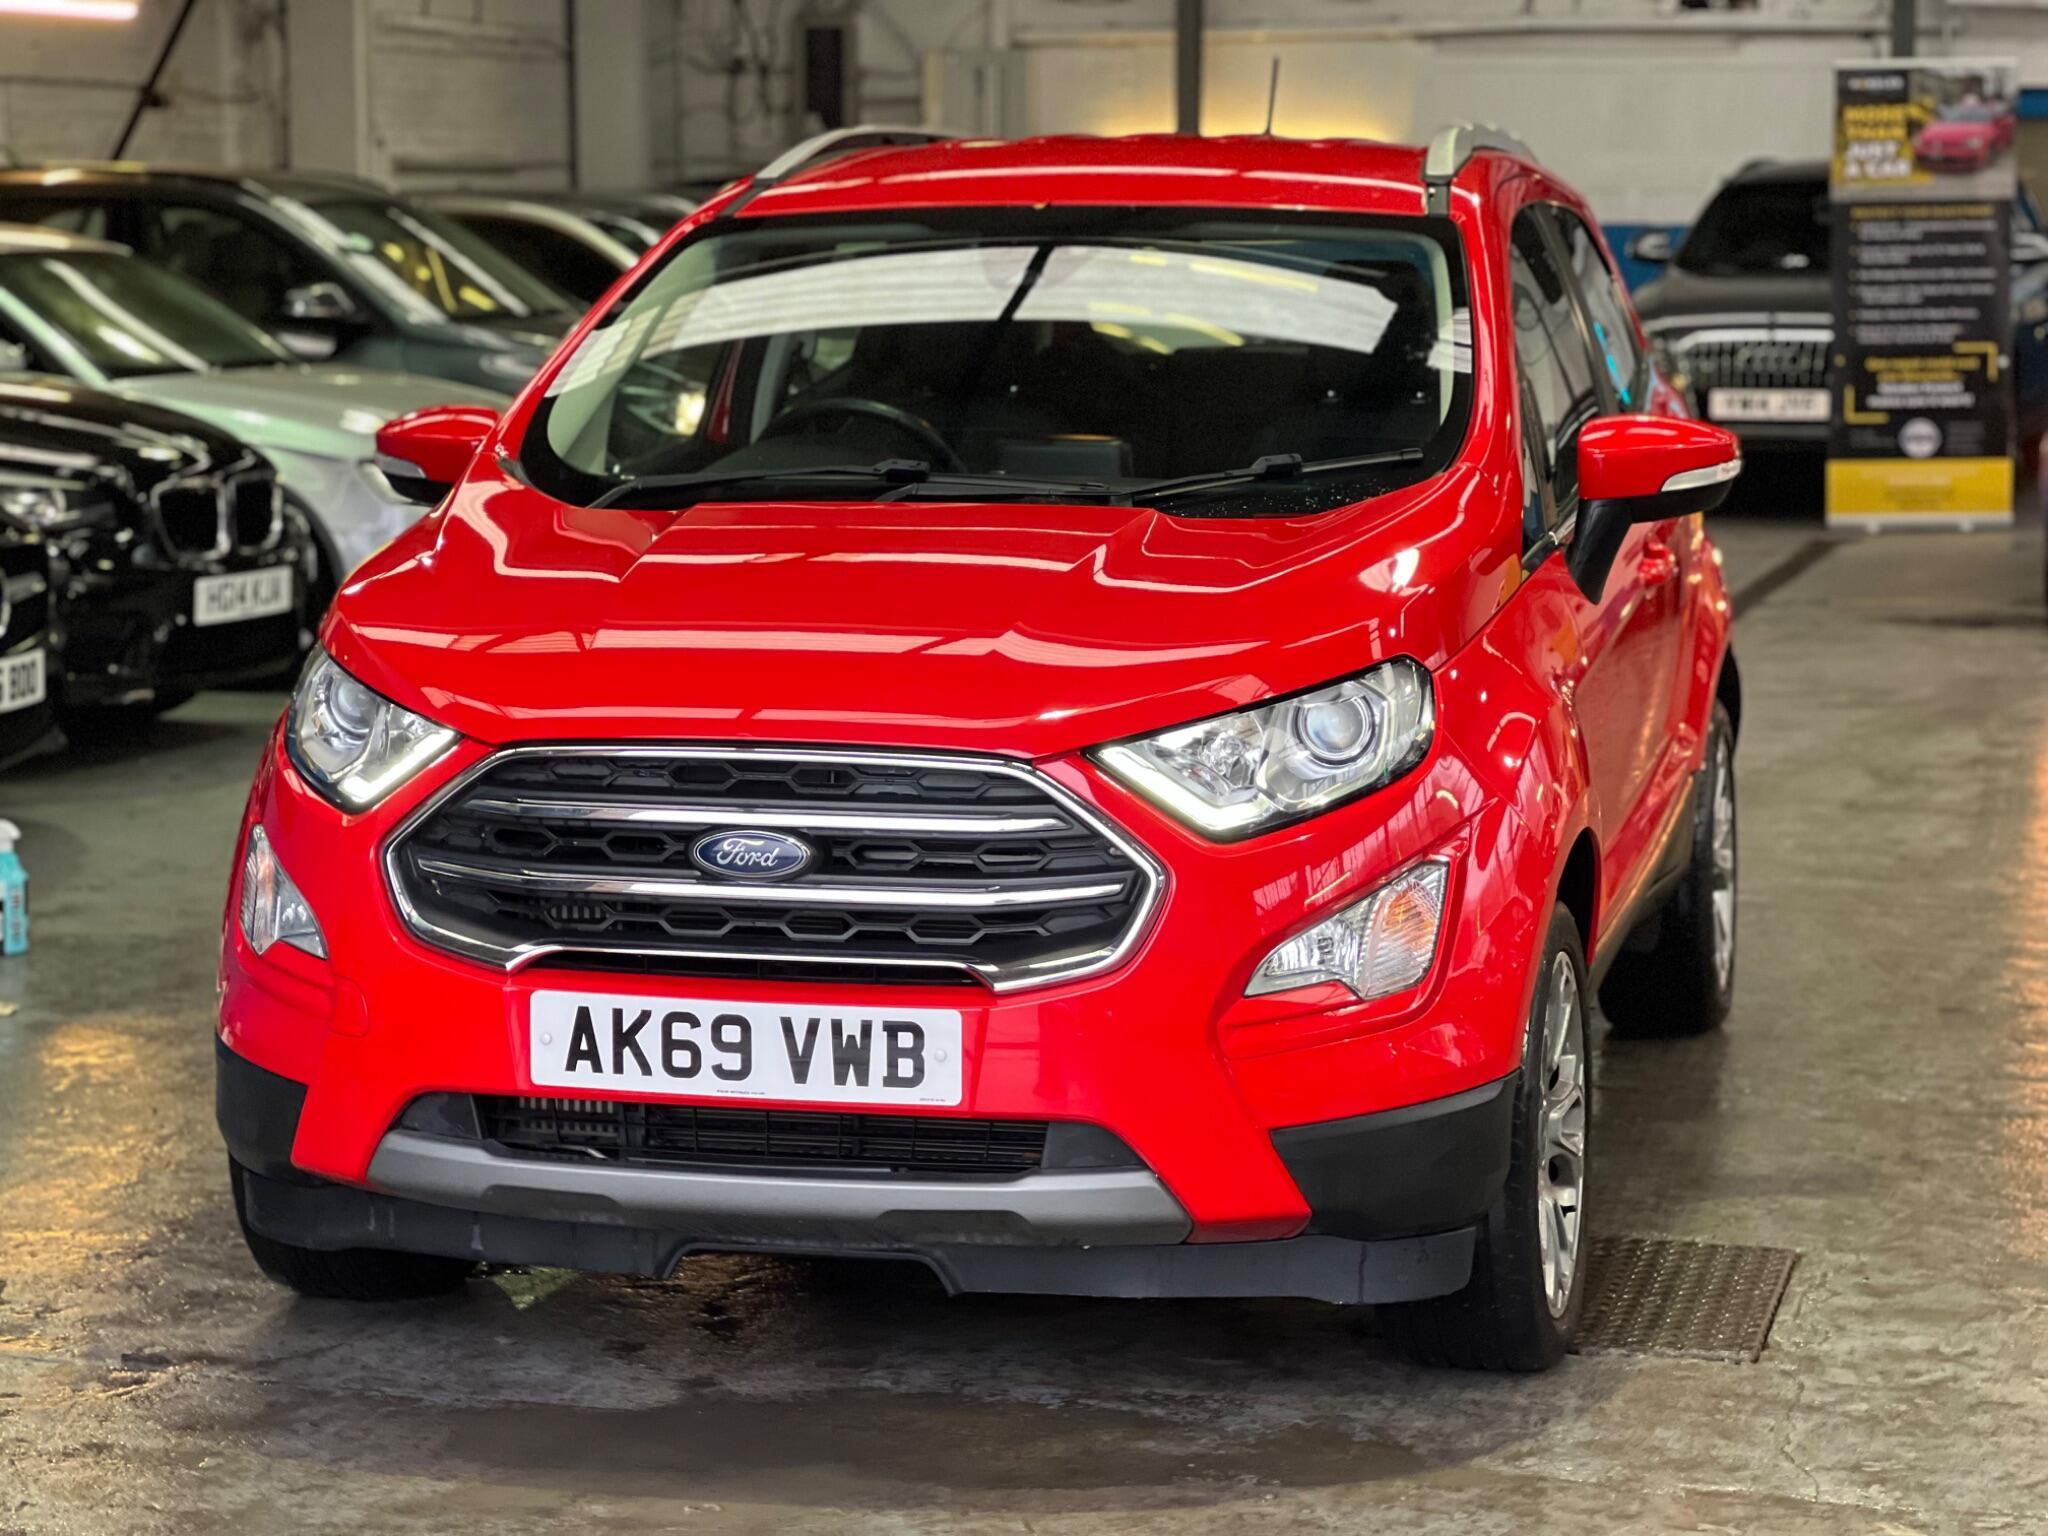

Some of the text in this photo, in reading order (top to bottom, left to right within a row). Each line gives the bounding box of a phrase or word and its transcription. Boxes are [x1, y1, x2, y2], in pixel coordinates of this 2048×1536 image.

[716, 838, 780, 867] Ford
[565, 1005, 925, 1088] AK69 VWB
